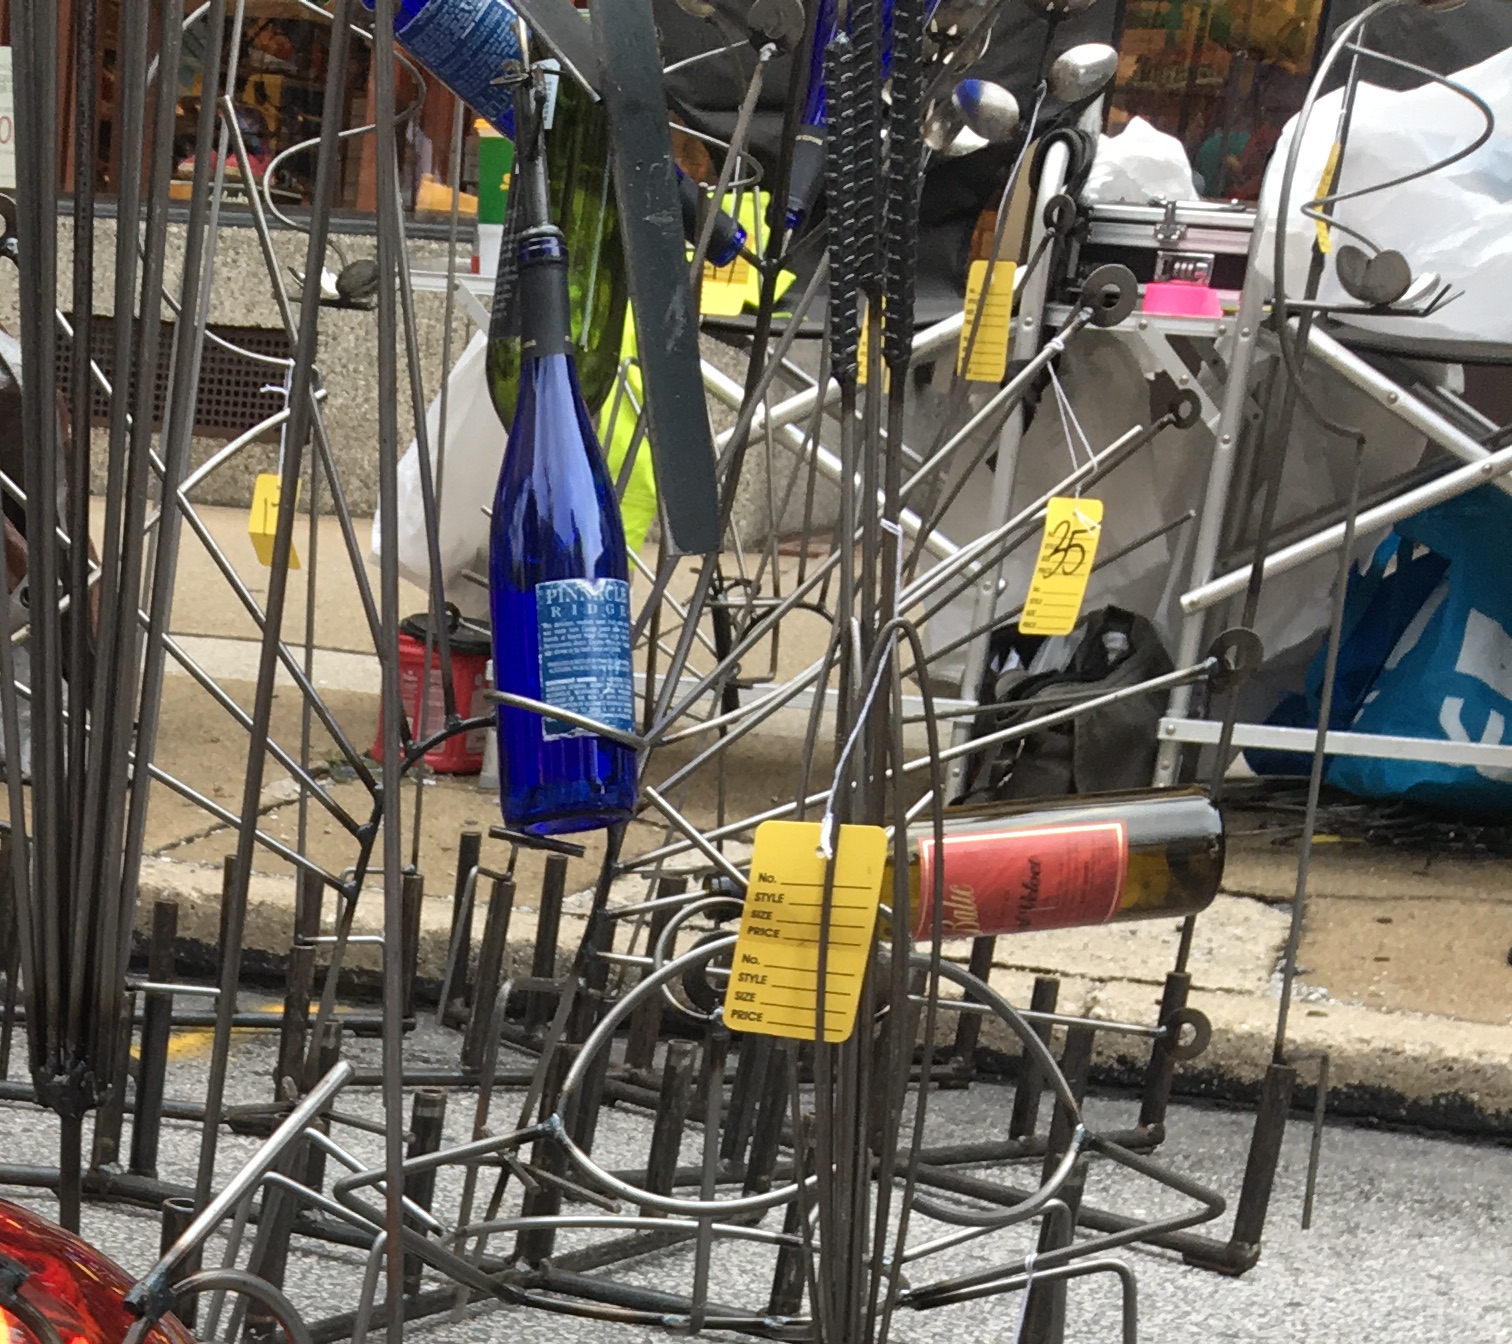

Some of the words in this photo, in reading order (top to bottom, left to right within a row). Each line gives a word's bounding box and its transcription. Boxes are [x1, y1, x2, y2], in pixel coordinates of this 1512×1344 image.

[758, 872, 777, 883] No.
[754, 892, 785, 903] STYLE
[751, 910, 773, 920] SIZE
[747, 926, 780, 938] PRICE
[742, 953, 760, 965] No.
[738, 972, 768, 985] STYLE
[734, 991, 756, 1002] SIZE
[731, 1009, 763, 1022] PRICE
